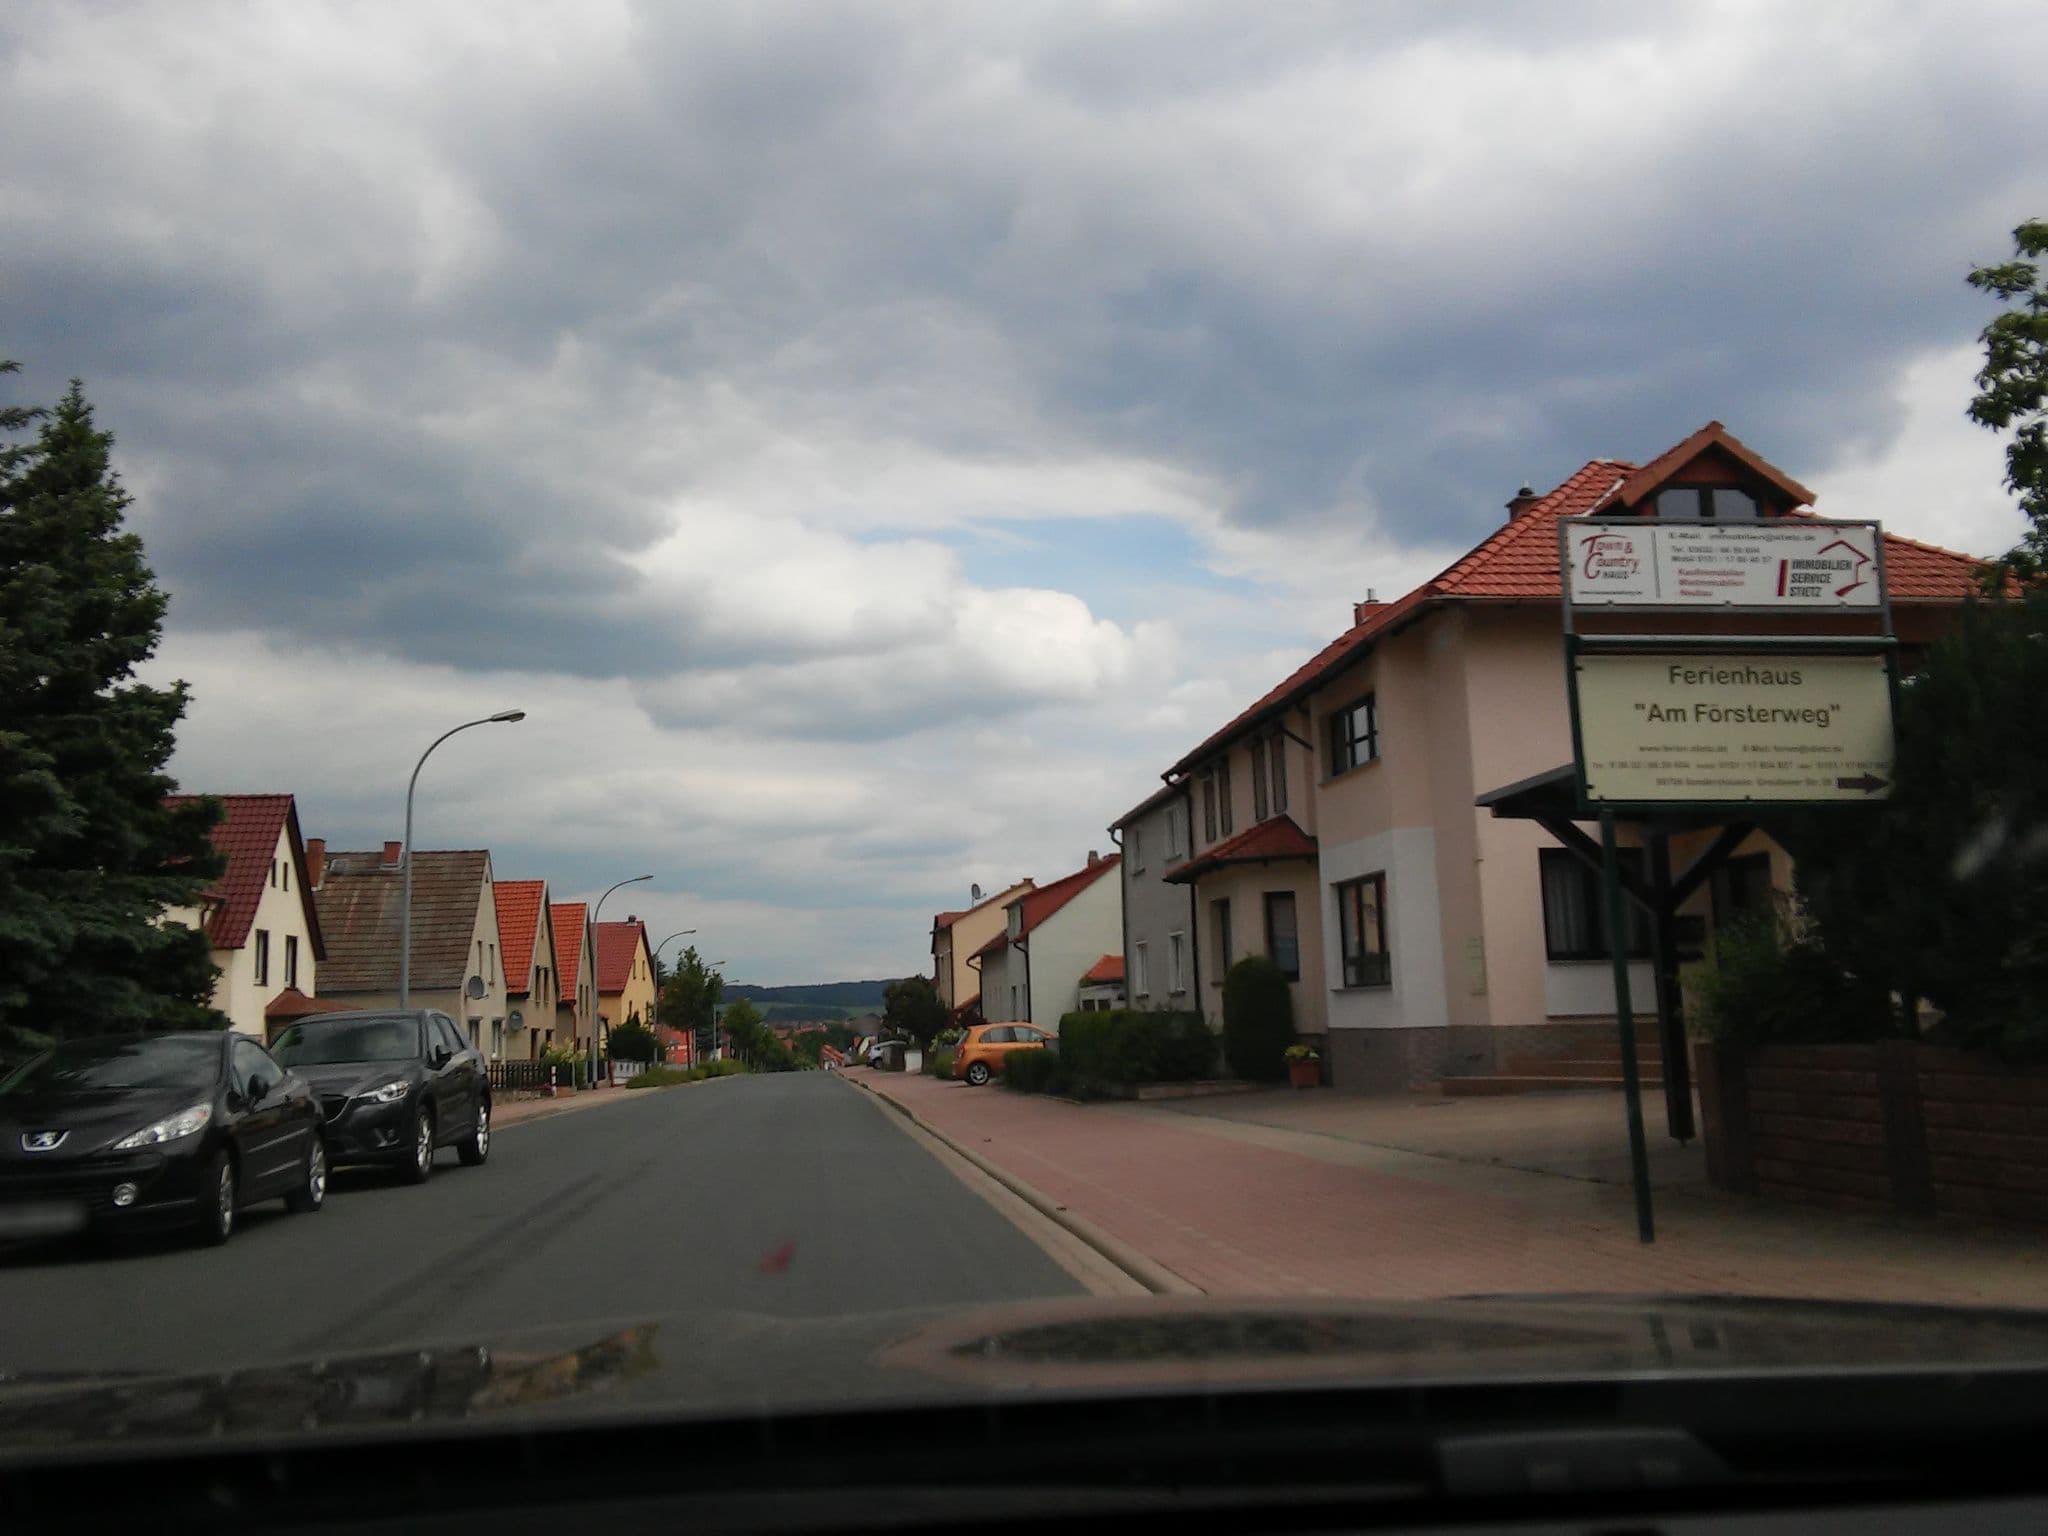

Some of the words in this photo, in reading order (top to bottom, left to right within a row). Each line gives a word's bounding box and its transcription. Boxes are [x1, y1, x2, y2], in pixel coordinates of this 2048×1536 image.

[1580, 534, 1626, 553] Town
[1584, 553, 1638, 579] Country
[1792, 559, 1852, 570] IMMOBILIEN
[1791, 572, 1832, 584] SERVICE
[1669, 665, 1803, 685] Ferienhaus
[1634, 703, 1687, 723] "Am
[1694, 702, 1840, 728] Försterweg"
